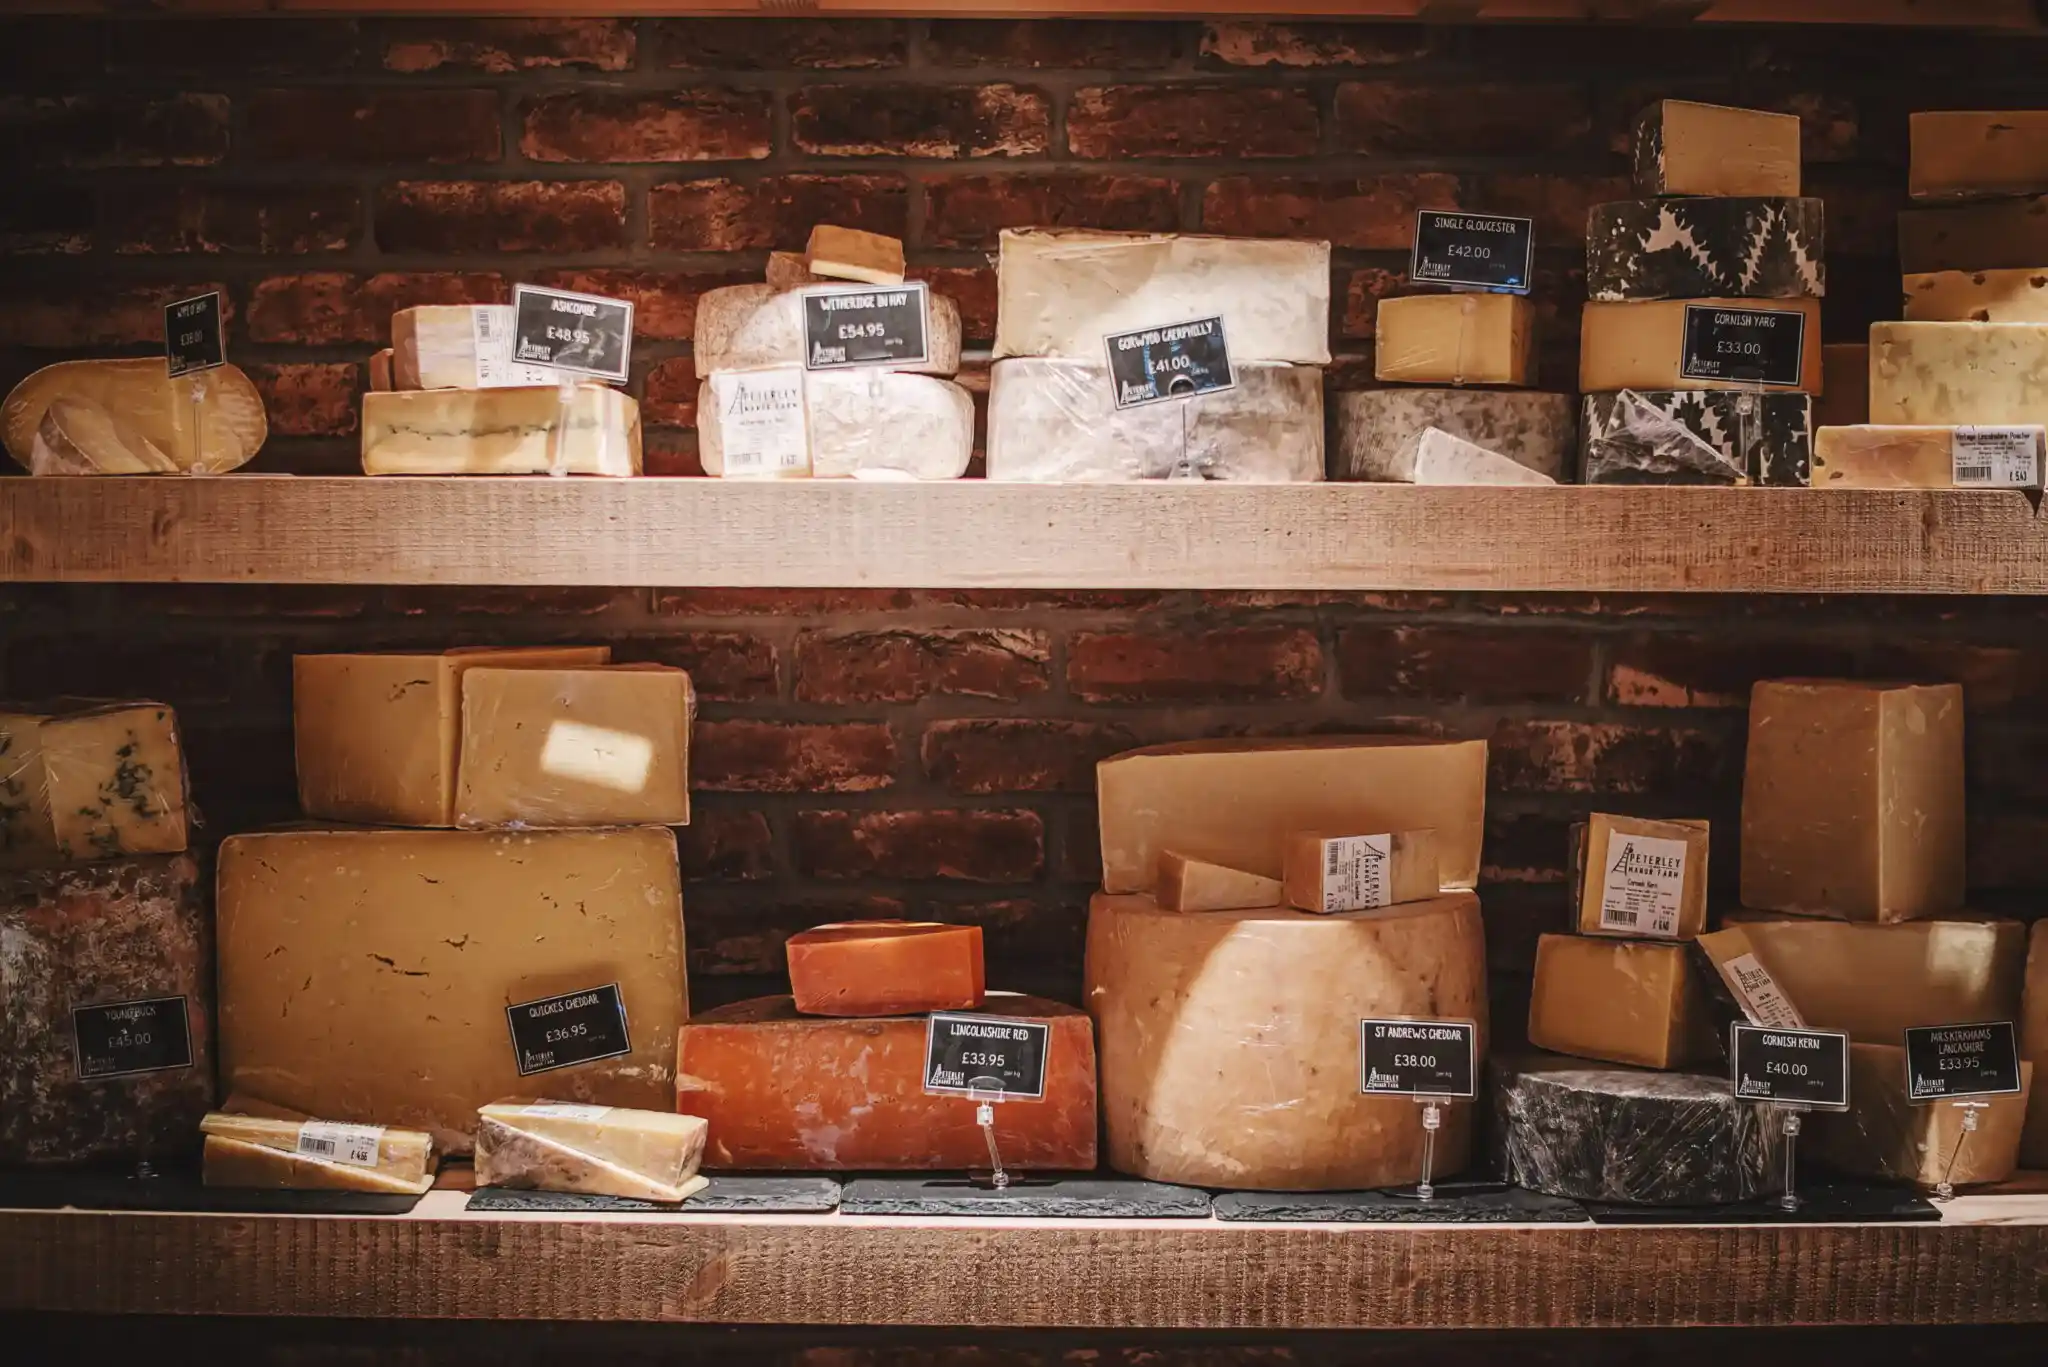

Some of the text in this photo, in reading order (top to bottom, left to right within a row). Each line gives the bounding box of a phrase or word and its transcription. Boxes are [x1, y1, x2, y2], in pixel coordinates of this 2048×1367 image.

[1434, 217, 1516, 234] SINGLE GLOUCESTER
[1448, 244, 1490, 259] £42.00
[552, 299, 598, 317] ASHCOMBE
[820, 296, 876, 311] WITHERIDGE
[889, 292, 908, 306] HAY
[1714, 312, 1776, 328] CORNISH YARG
[546, 326, 592, 344] £48.95
[838, 322, 885, 340] £54.95
[1118, 321, 1213, 351] GORWYDD CAERPHILLY
[1717, 341, 1760, 355] £33.00
[1148, 354, 1190, 375] £41.00
[1630, 853, 1681, 868] PETERLEY
[1628, 866, 1679, 879] MANOR FARM
[529, 994, 599, 1018] QUICKES CHEDDAR
[546, 1023, 587, 1043] £36.95
[950, 1023, 1029, 1041] LINCOLNSHIRE RED
[1375, 1026, 1462, 1041] ST ANDREWS CHEDDAR
[108, 1032, 151, 1049] £45.00
[1762, 1034, 1820, 1050] CORNISH KERN
[1938, 1041, 1985, 1054] LANCASHIRE
[962, 1052, 1005, 1067] £33.95
[1394, 1054, 1436, 1068] £38.00
[1940, 1057, 1980, 1070] £33.95
[1766, 1061, 1808, 1076] £40.00
